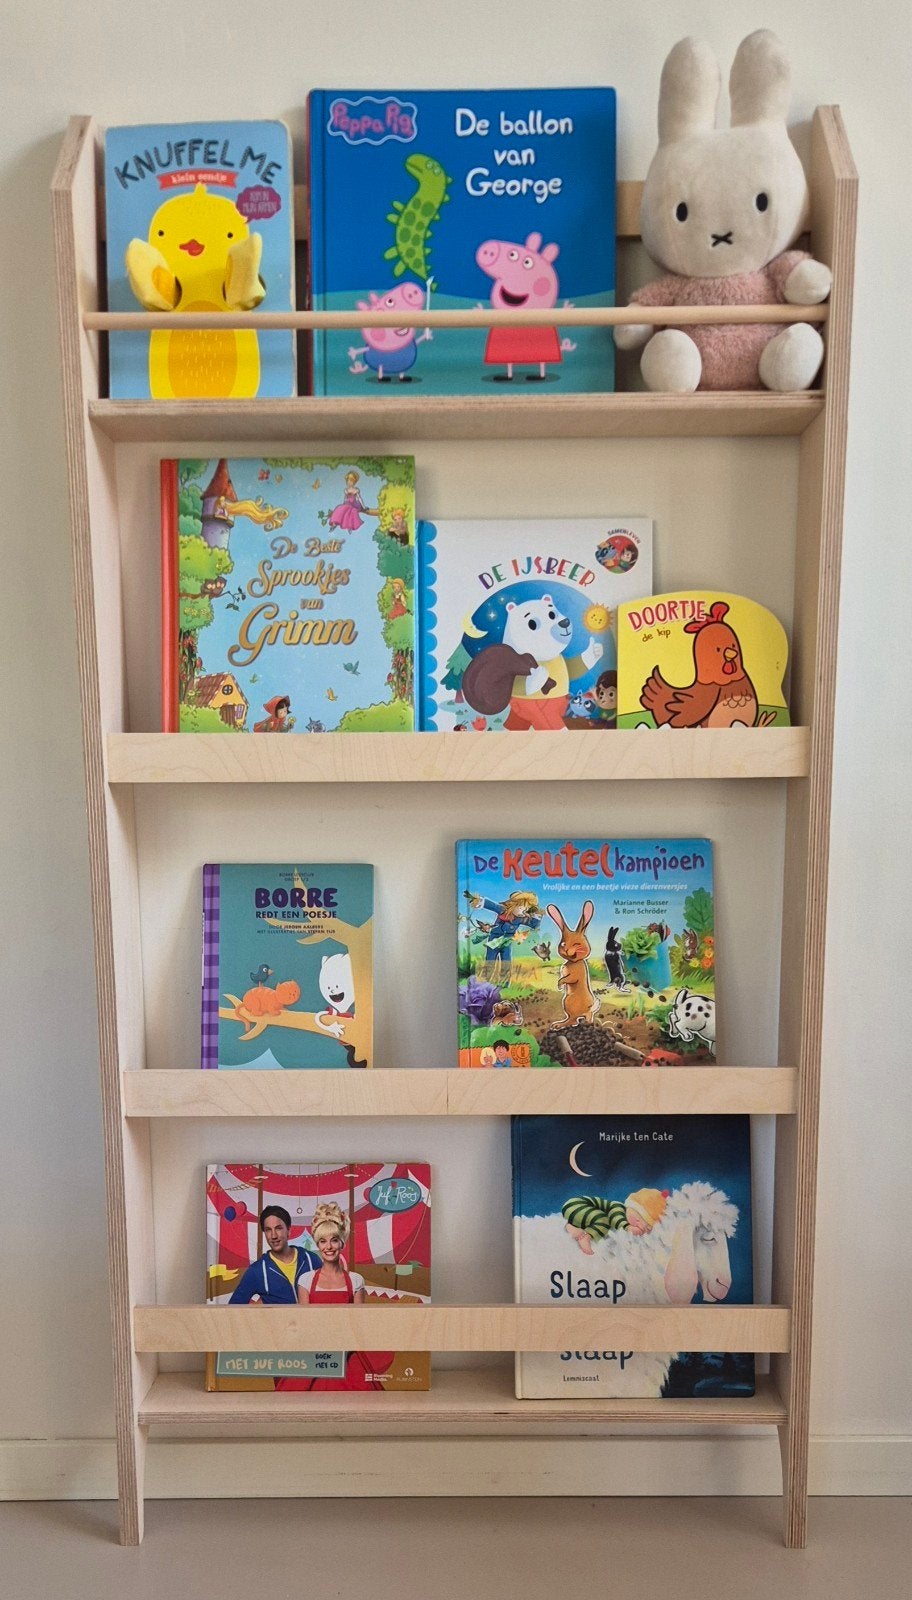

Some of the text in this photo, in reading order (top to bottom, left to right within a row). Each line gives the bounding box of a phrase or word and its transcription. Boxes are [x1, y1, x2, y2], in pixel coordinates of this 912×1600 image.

[333, 103, 414, 139] Peppa Pig
[455, 108, 573, 137] De ballon
[114, 138, 282, 190] KNUFFEL ME
[494, 148, 535, 166] van
[171, 173, 227, 183] klein eendje
[465, 167, 562, 204] George
[270, 536, 346, 559] De Beste
[247, 559, 351, 598] Sprookjes
[478, 556, 596, 590] DE IJSBEER
[300, 598, 324, 610] van
[628, 600, 707, 631] DOORTJE
[227, 602, 358, 667] Grimm
[642, 628, 671, 642] de kip
[254, 887, 338, 909] BORRE
[542, 883, 570, 893] Vrolijke
[597, 883, 619, 892] beetje
[640, 883, 688, 892] dierenversjes
[255, 911, 337, 919] REDT EEN POESJE
[599, 1131, 674, 1143] Marijke ten Cate
[550, 1270, 626, 1304] Slaap
[225, 1358, 308, 1370] MET JUF ROOS
